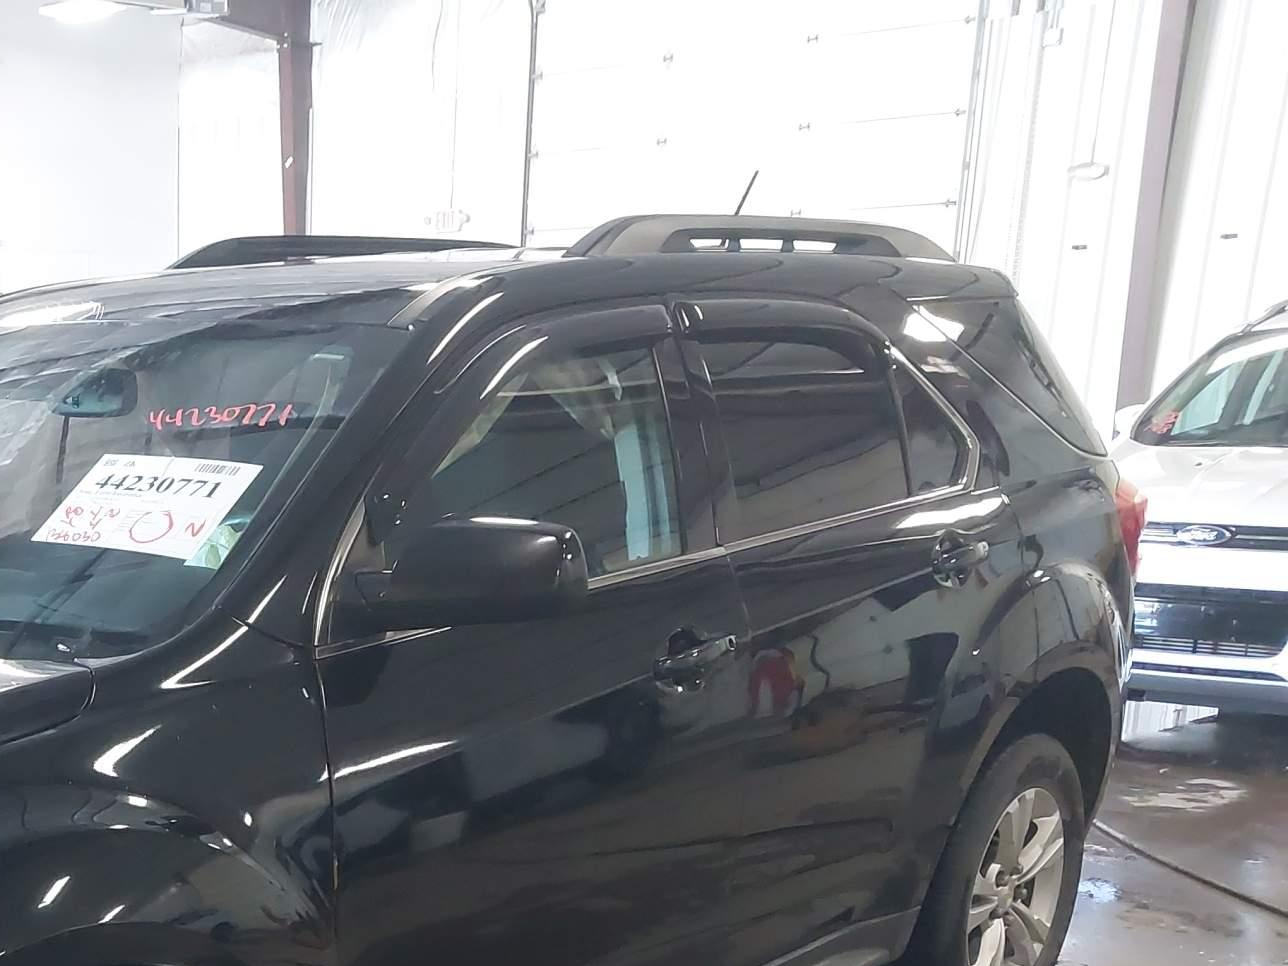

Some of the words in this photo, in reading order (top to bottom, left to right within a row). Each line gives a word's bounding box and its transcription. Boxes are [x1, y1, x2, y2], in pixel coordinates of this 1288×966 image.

[149, 403, 293, 431] 44230771
[96, 473, 223, 499] 44230771
[1182, 528, 1219, 543] Ford
